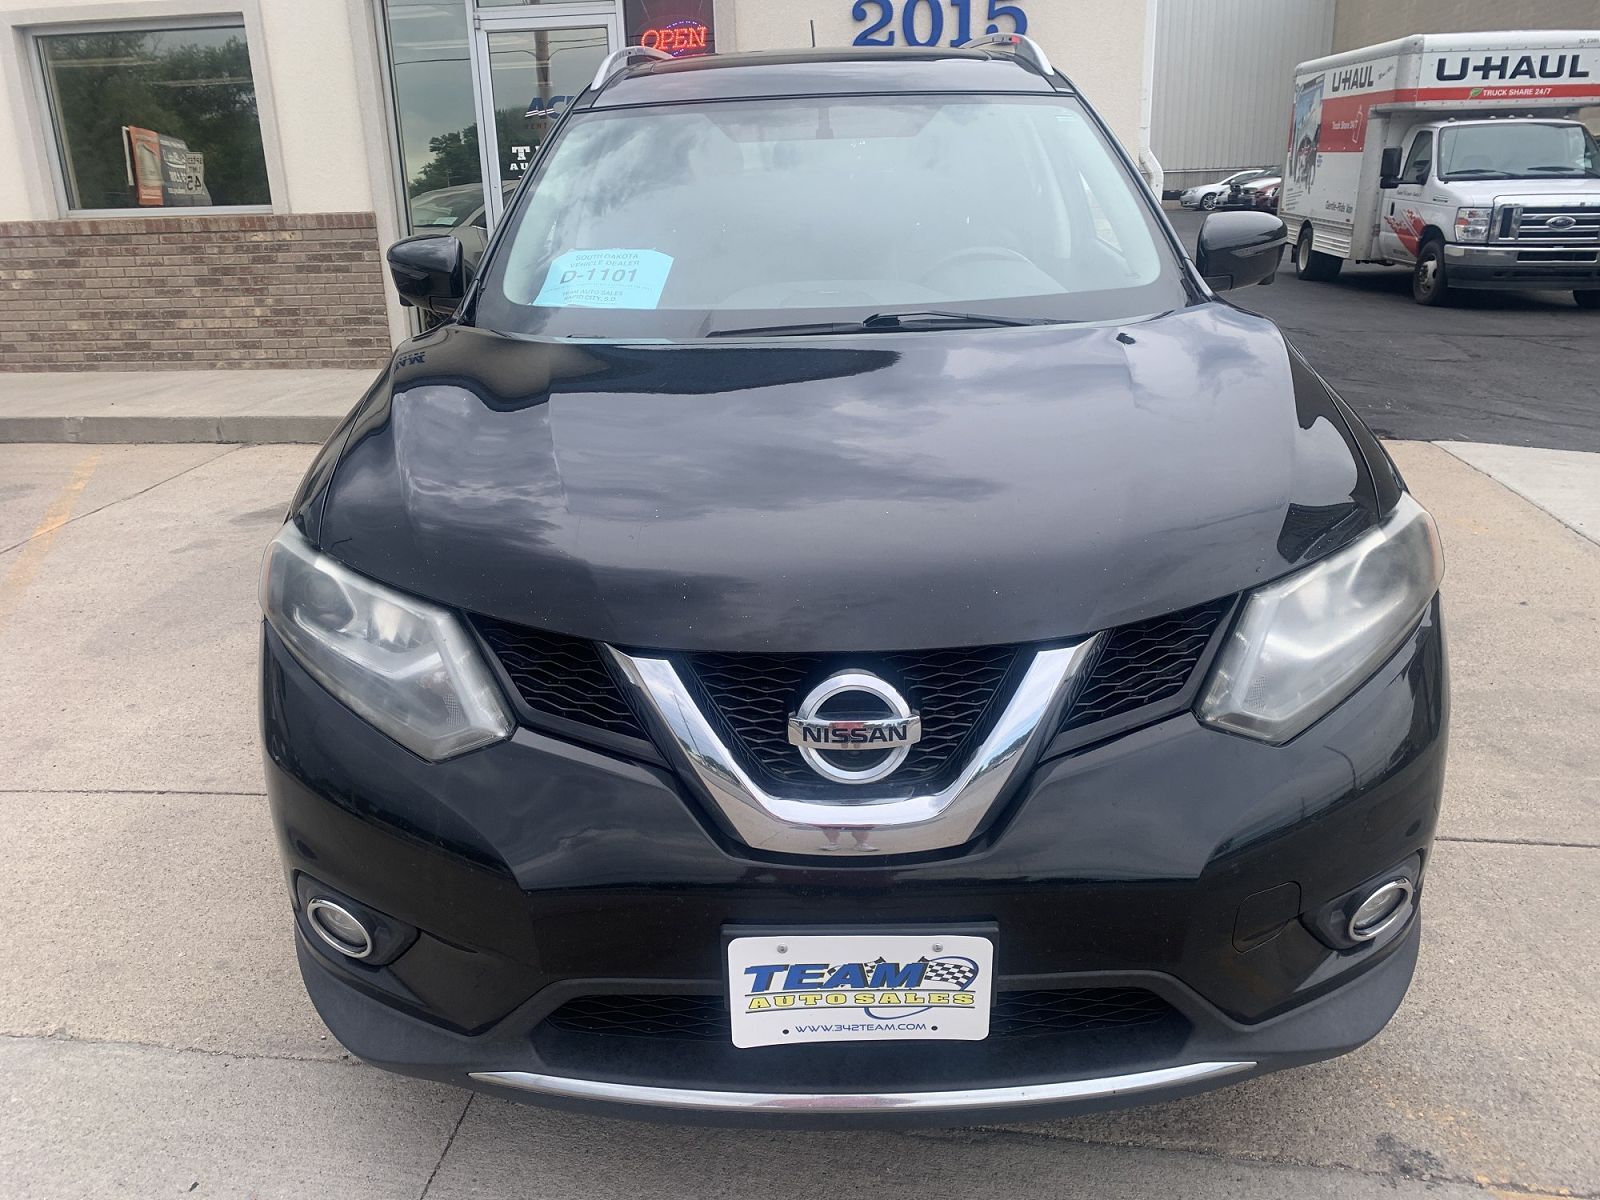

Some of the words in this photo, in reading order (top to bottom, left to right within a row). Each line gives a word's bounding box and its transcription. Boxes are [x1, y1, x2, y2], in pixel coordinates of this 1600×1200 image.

[852, 0, 1028, 48] 2015
[641, 26, 708, 50] OPEN
[1436, 54, 1589, 81] U-HAUL
[1332, 65, 1374, 92] U-HAUL
[1483, 88, 1507, 96] TRUCK
[1508, 88, 1533, 96] SHARE
[1535, 87, 1552, 95] 24/7
[575, 253, 602, 261] SOUTH
[559, 268, 638, 284] D-1101
[802, 724, 908, 744] NISSAN
[744, 962, 931, 993] TEAM
[748, 994, 847, 1010] AUTO
[853, 992, 976, 1006] SALES
[795, 1022, 927, 1034] WWW.342TEAM.COM
